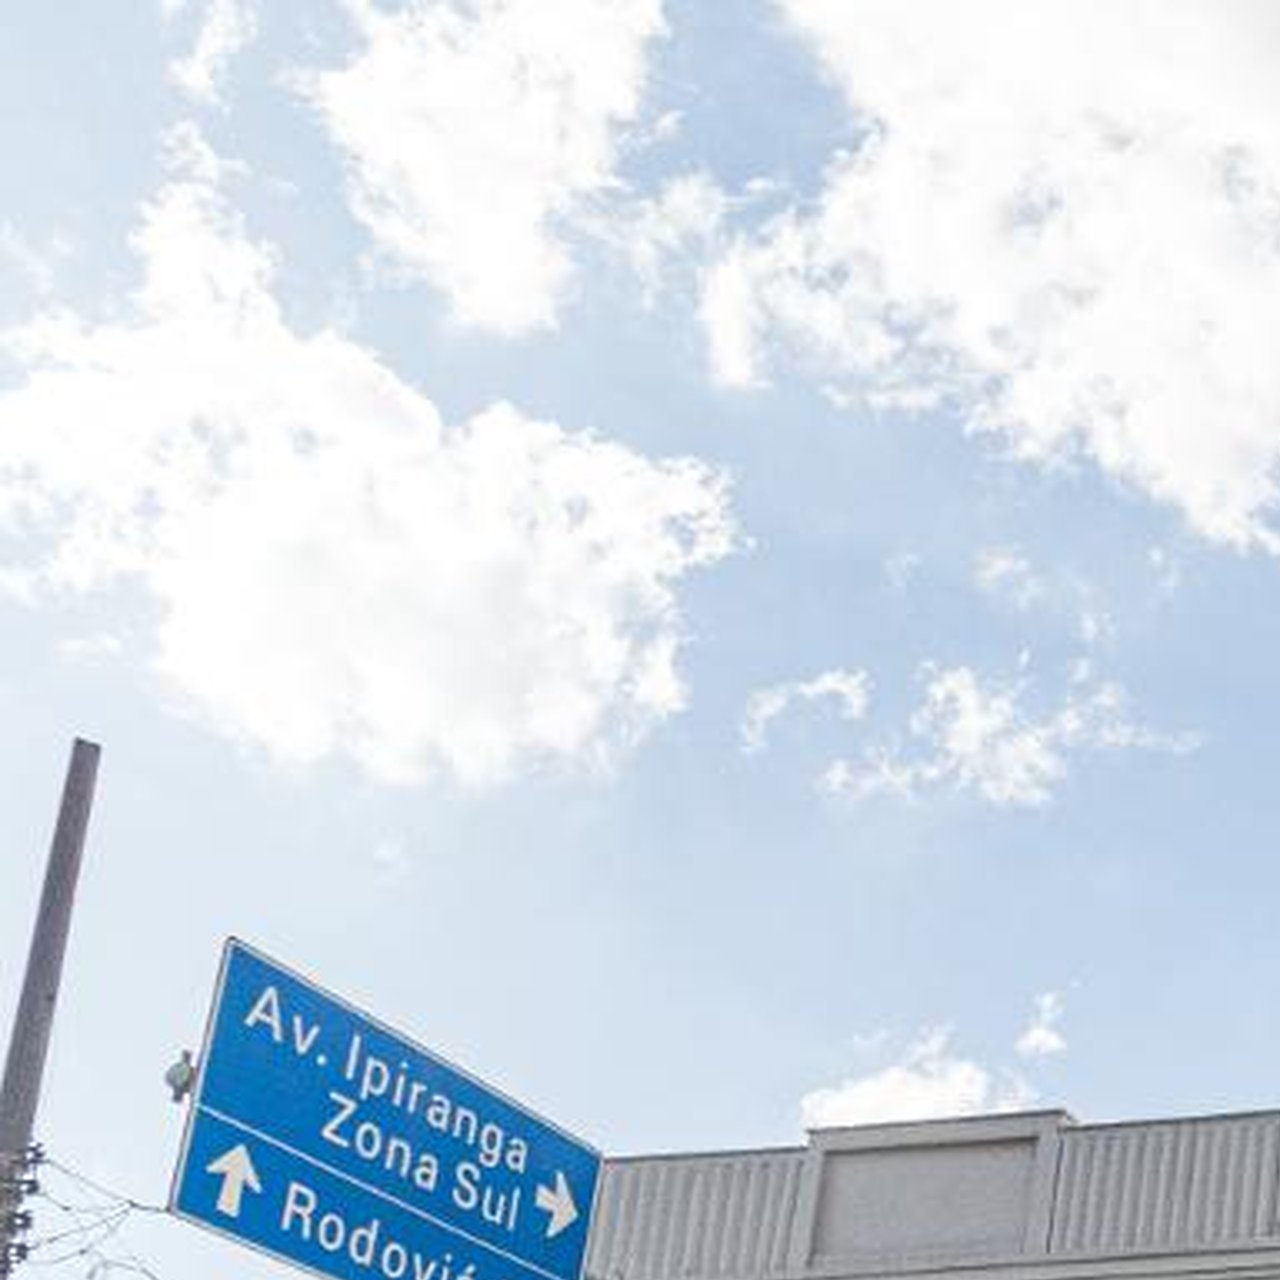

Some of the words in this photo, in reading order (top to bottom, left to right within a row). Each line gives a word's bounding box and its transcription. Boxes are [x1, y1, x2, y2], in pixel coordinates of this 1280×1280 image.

[244, 986, 326, 1066] Av.
[345, 1035, 527, 1174] Ipiranga
[321, 1091, 438, 1191] Zona
[452, 1161, 520, 1231] Sul
